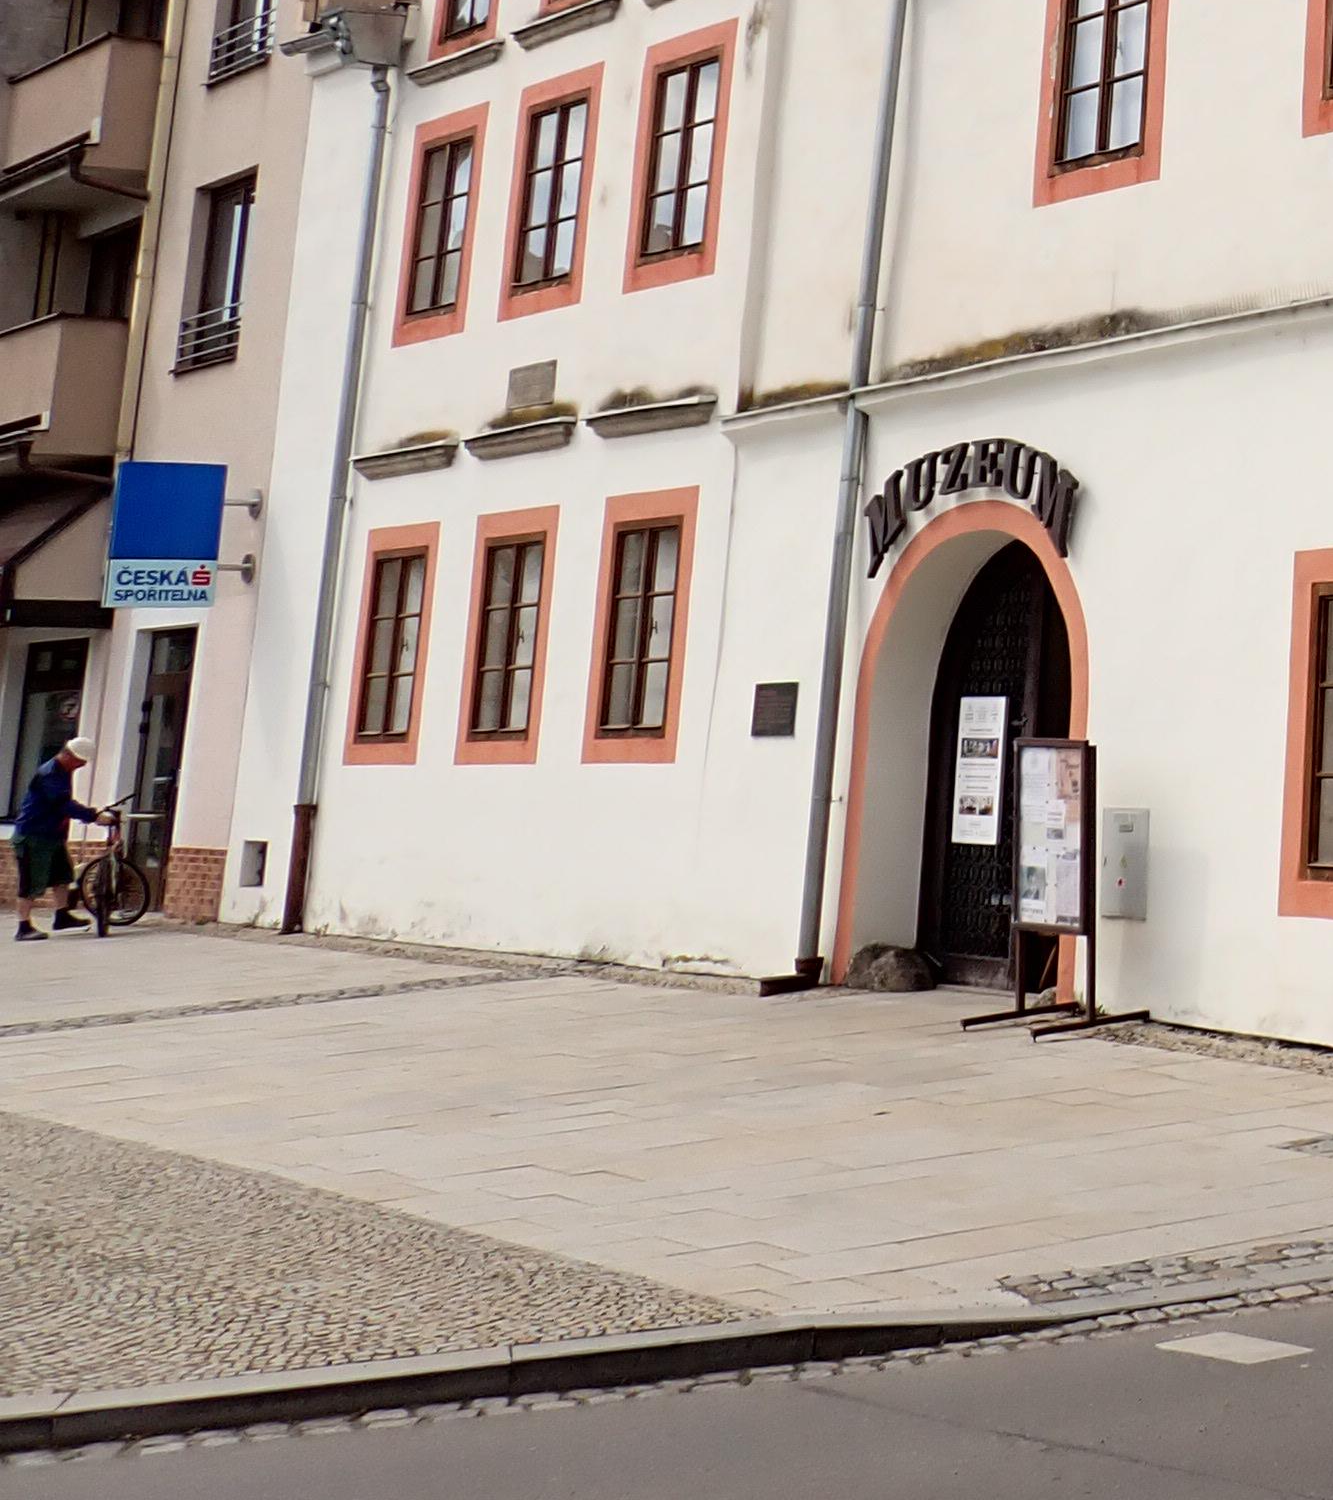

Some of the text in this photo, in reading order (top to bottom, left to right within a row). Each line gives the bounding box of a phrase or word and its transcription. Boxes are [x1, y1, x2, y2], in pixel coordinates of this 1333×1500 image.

[864, 437, 1080, 579] MUZEUM
[116, 565, 190, 586] ČESKÁ
[113, 586, 208, 601] SPOŘITELNA
